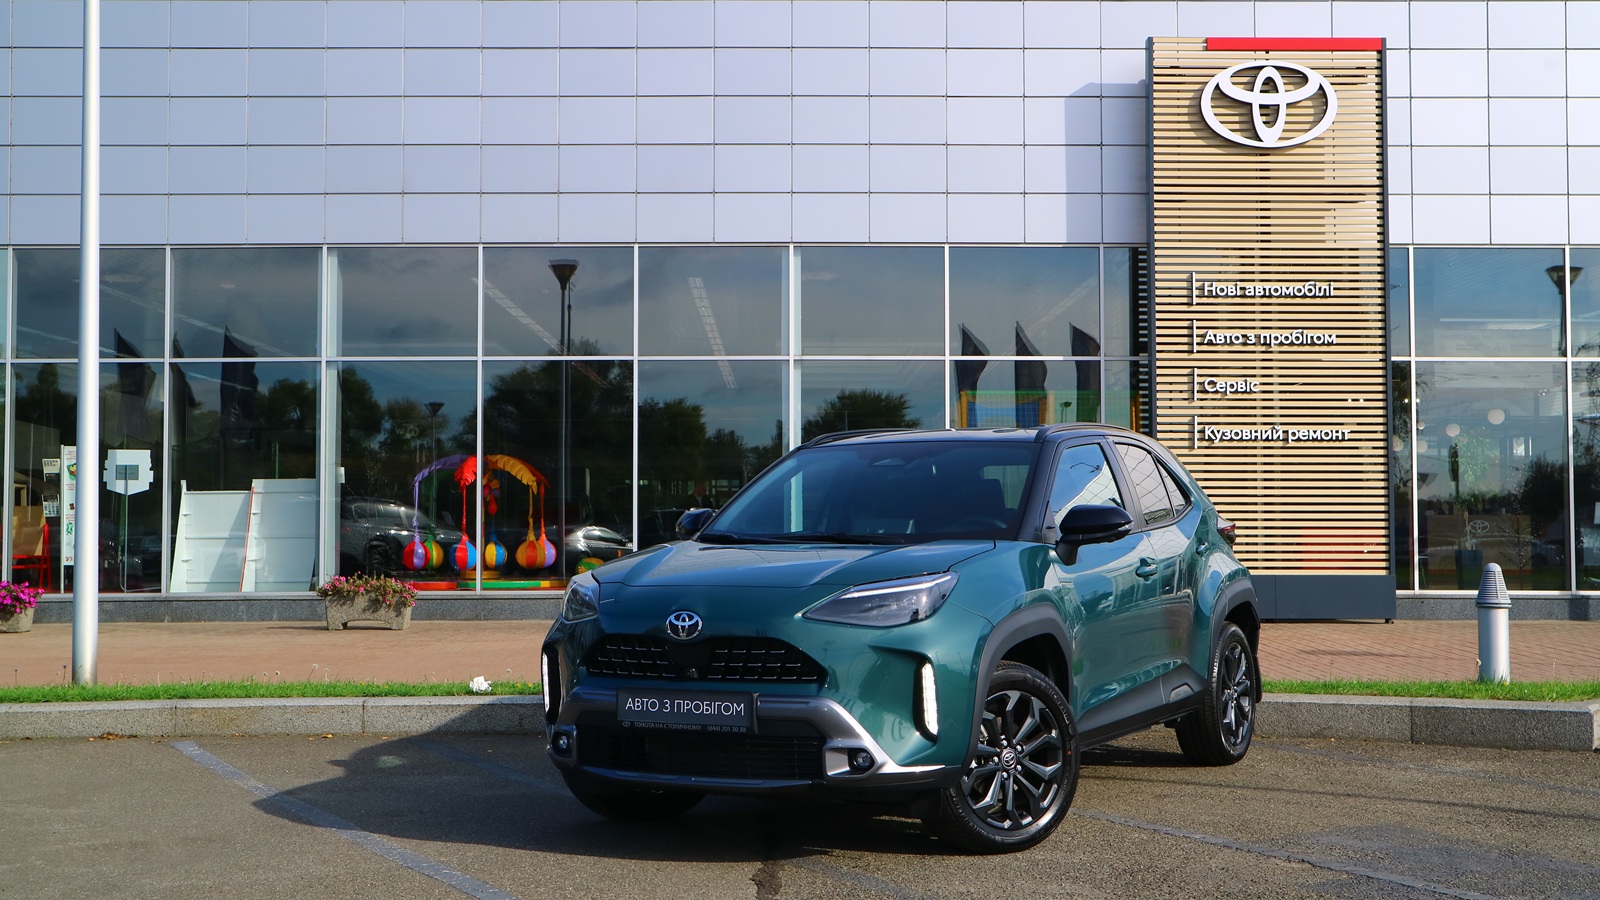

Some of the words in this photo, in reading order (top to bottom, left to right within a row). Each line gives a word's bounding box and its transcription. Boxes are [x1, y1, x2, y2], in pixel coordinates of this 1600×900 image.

[1203, 282, 1241, 296] Нові
[1245, 281, 1334, 297] автомобілі
[1203, 330, 1243, 344] Авто
[1246, 333, 1256, 344] з
[1260, 329, 1337, 347] пробігом
[1203, 378, 1260, 395] Сервіс
[1204, 426, 1284, 443] Кузовний
[1288, 429, 1351, 443] ремонт
[625, 697, 659, 712] АВТО
[662, 699, 671, 712] З
[674, 700, 745, 716] ПРОБІГОМ
